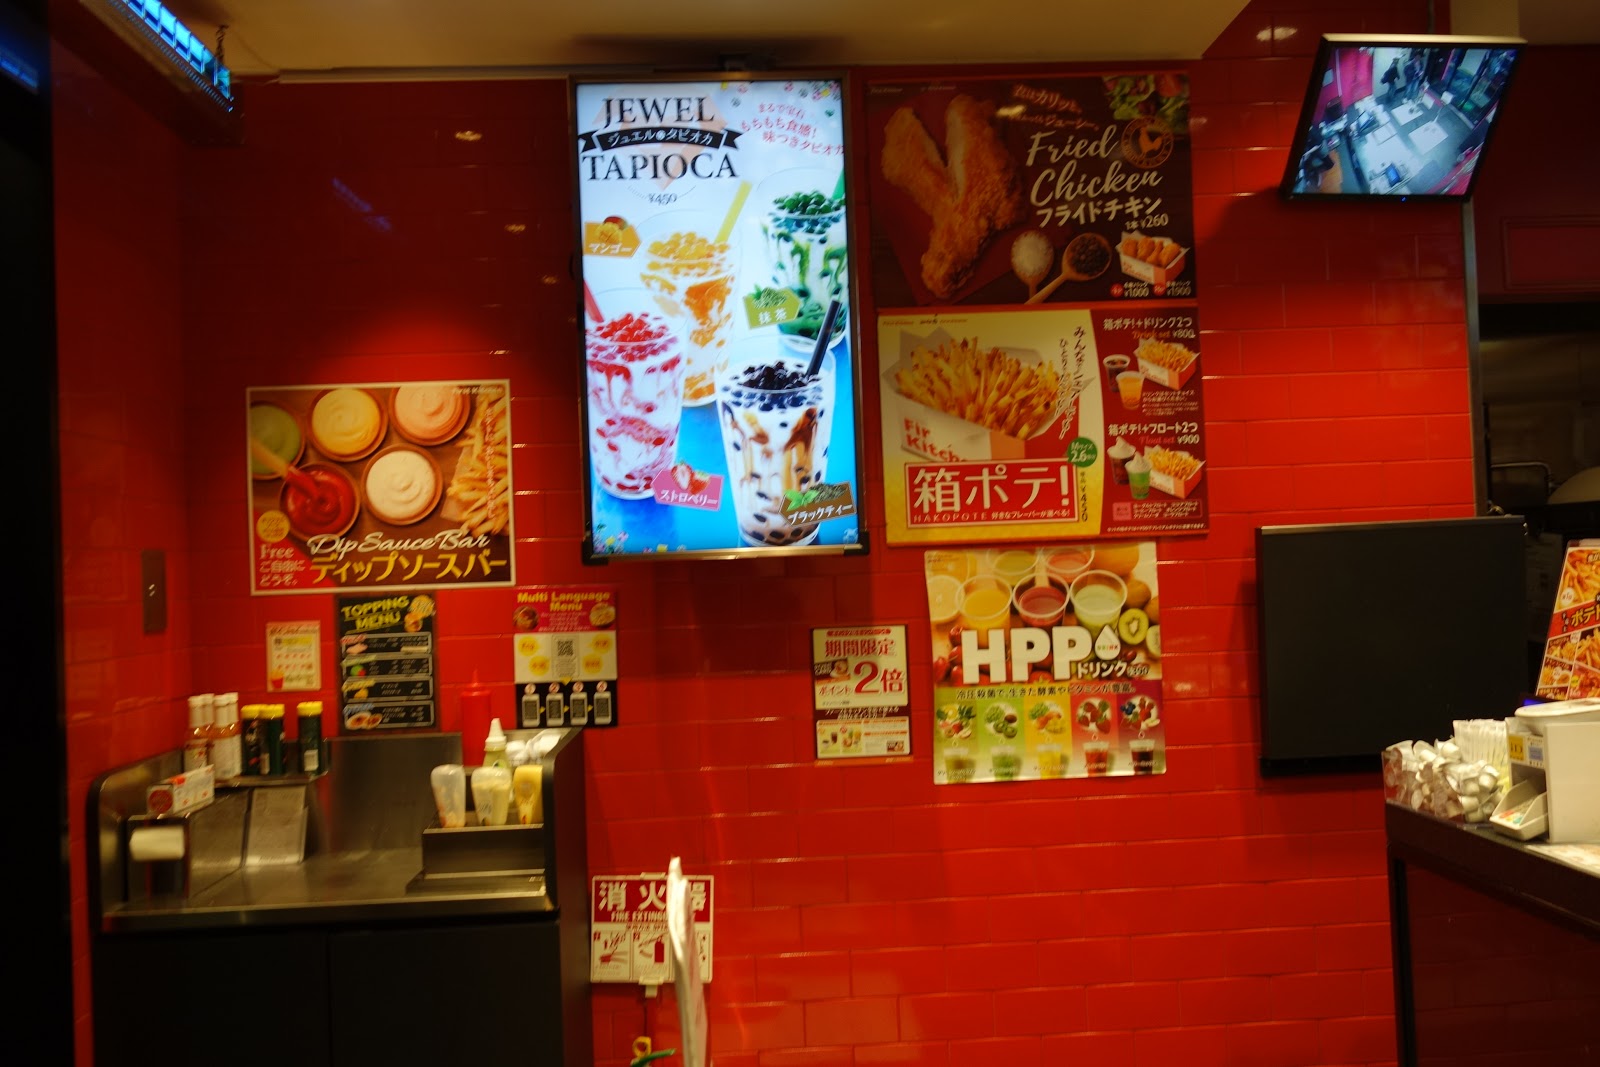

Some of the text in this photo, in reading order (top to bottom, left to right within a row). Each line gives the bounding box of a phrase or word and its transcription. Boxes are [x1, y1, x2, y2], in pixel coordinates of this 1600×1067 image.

[602, 97, 715, 129] JEWEL
[1025, 124, 1120, 167] Fried
[581, 153, 740, 181] TAPIOCA
[1030, 160, 1163, 206] Chicken
[1036, 196, 1163, 228] フライドチキン
[1141, 213, 1169, 229] ¥260
[589, 242, 632, 253] マンゴー
[907, 434, 968, 463] Kitch
[660, 489, 718, 506] ストロベリー
[913, 464, 1070, 514] 箱ポテ!
[787, 504, 854, 525] ブラックティー
[913, 512, 987, 523] HAKOPOTE
[306, 527, 490, 561] Dip Sauce Bar
[310, 549, 508, 584] ディップソースバー
[341, 595, 410, 620] TOPPING
[517, 590, 610, 603] Multi Language
[550, 602, 583, 612] Menu
[355, 610, 402, 630] MENU
[825, 638, 895, 657] 期間限定
[961, 625, 1093, 685] HPP
[1077, 661, 1127, 678] ドリンク
[819, 685, 850, 696] ポイント
